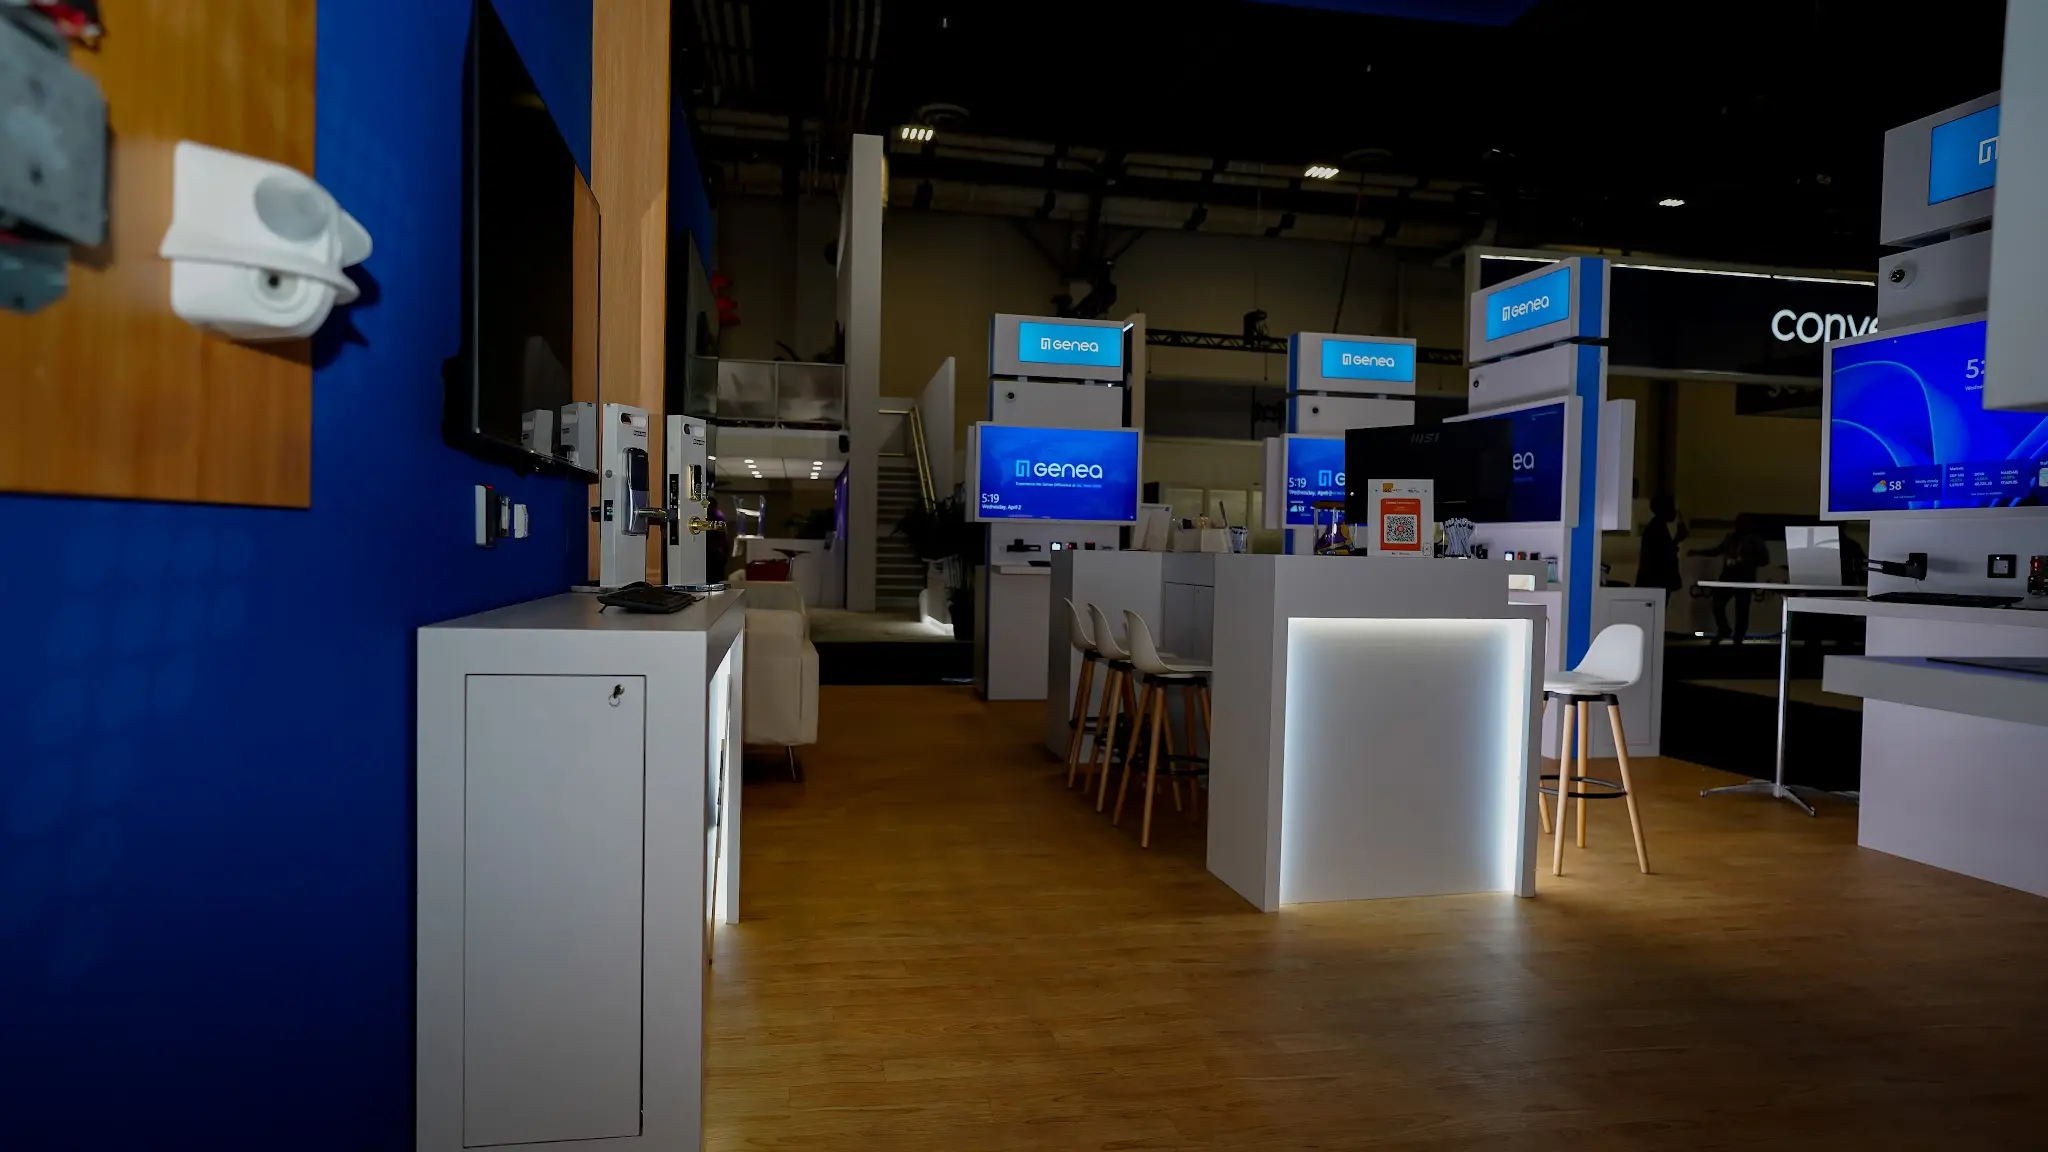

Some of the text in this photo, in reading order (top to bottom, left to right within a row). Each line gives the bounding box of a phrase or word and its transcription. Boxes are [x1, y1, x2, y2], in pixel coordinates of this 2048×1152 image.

[1511, 295, 1550, 318] Genea
[1771, 308, 1879, 344] conv
[1052, 340, 1099, 353] Genea
[1353, 355, 1395, 368] Genea
[1033, 462, 1103, 479] Genea
[1288, 477, 1307, 488] 5:19
[981, 493, 1000, 504] 5:19
